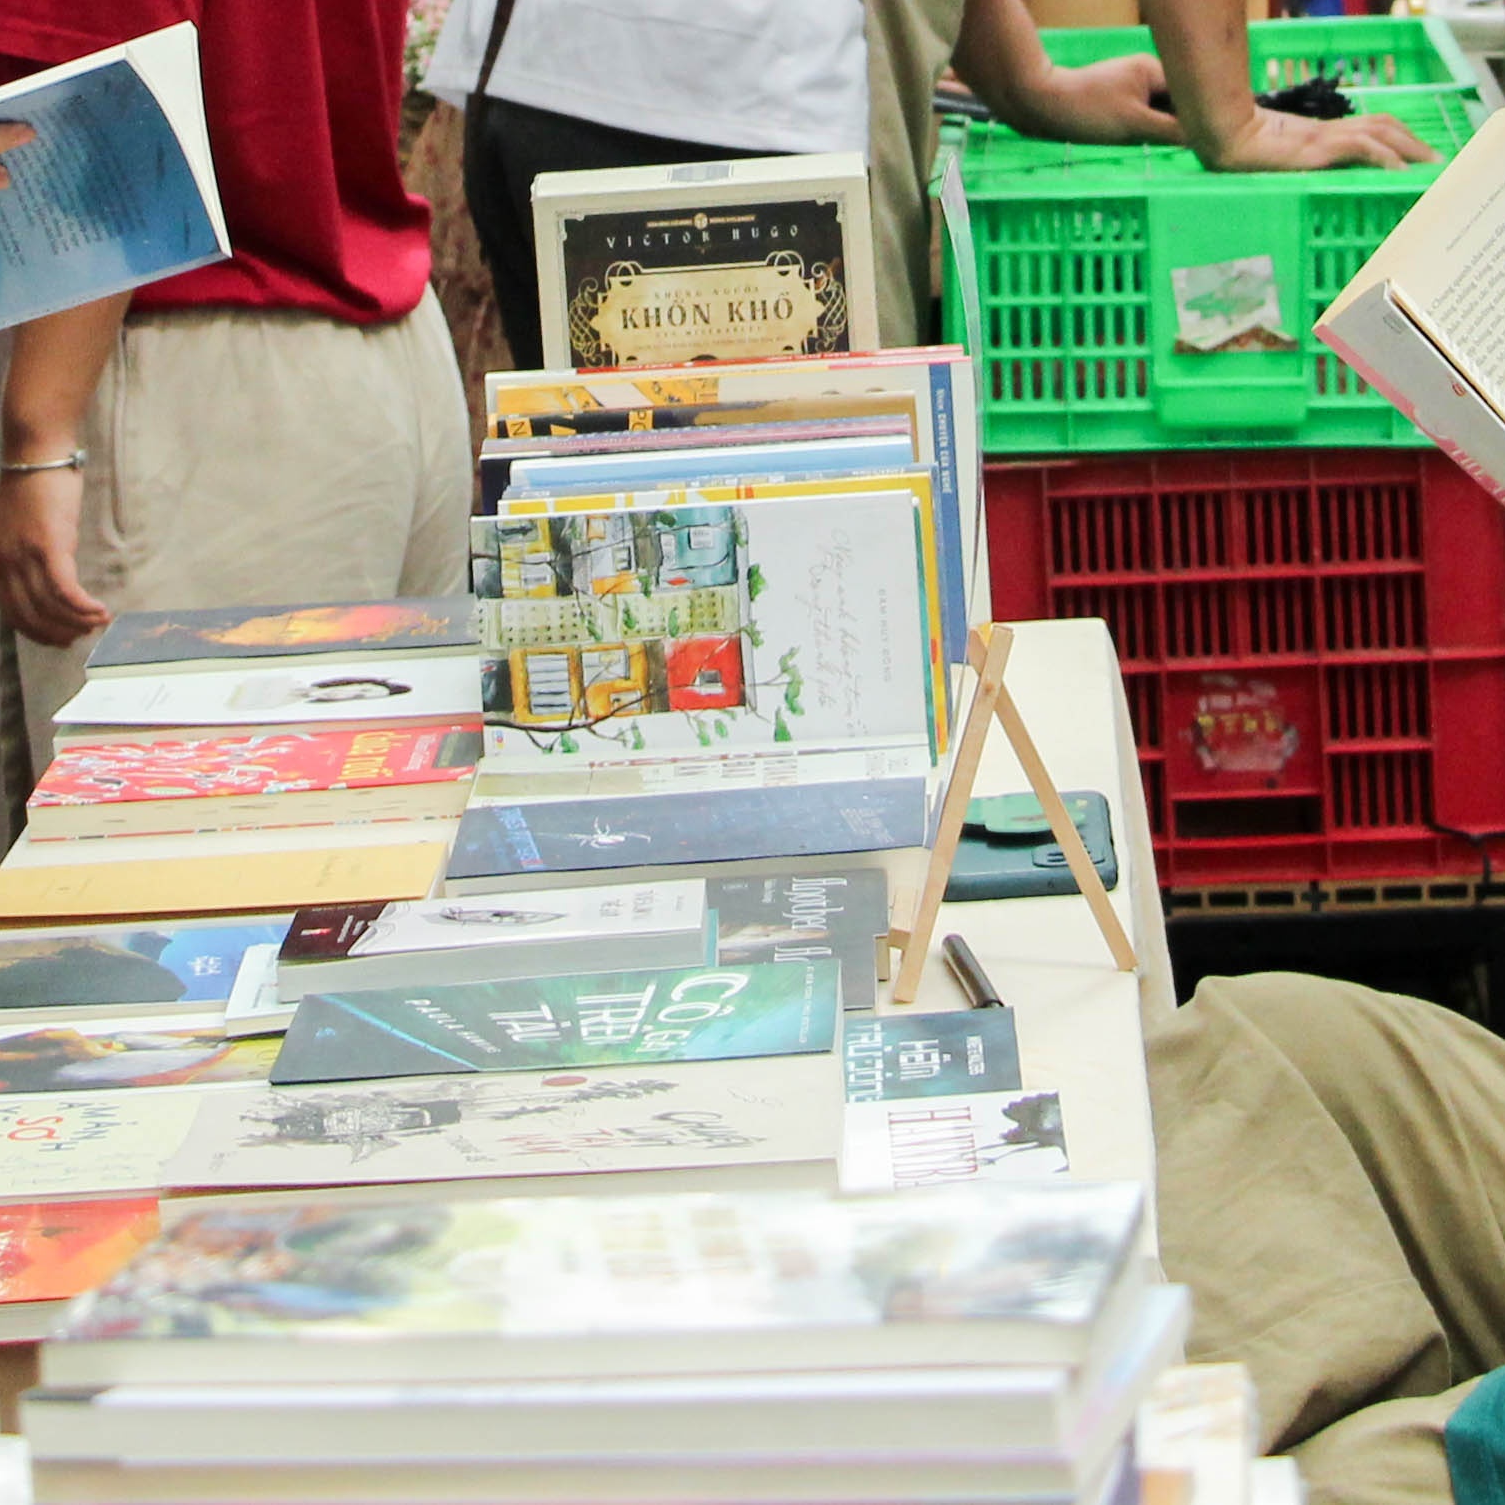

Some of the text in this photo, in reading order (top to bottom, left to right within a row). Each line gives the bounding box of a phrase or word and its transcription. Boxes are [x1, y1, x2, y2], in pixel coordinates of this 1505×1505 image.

[605, 223, 800, 249] VICTOR HUGO
[405, 998, 465, 1032] PAULA
[575, 979, 659, 1046] TRÊN
[656, 972, 750, 1023] CÔ
[488, 1002, 573, 1043] TÀU
